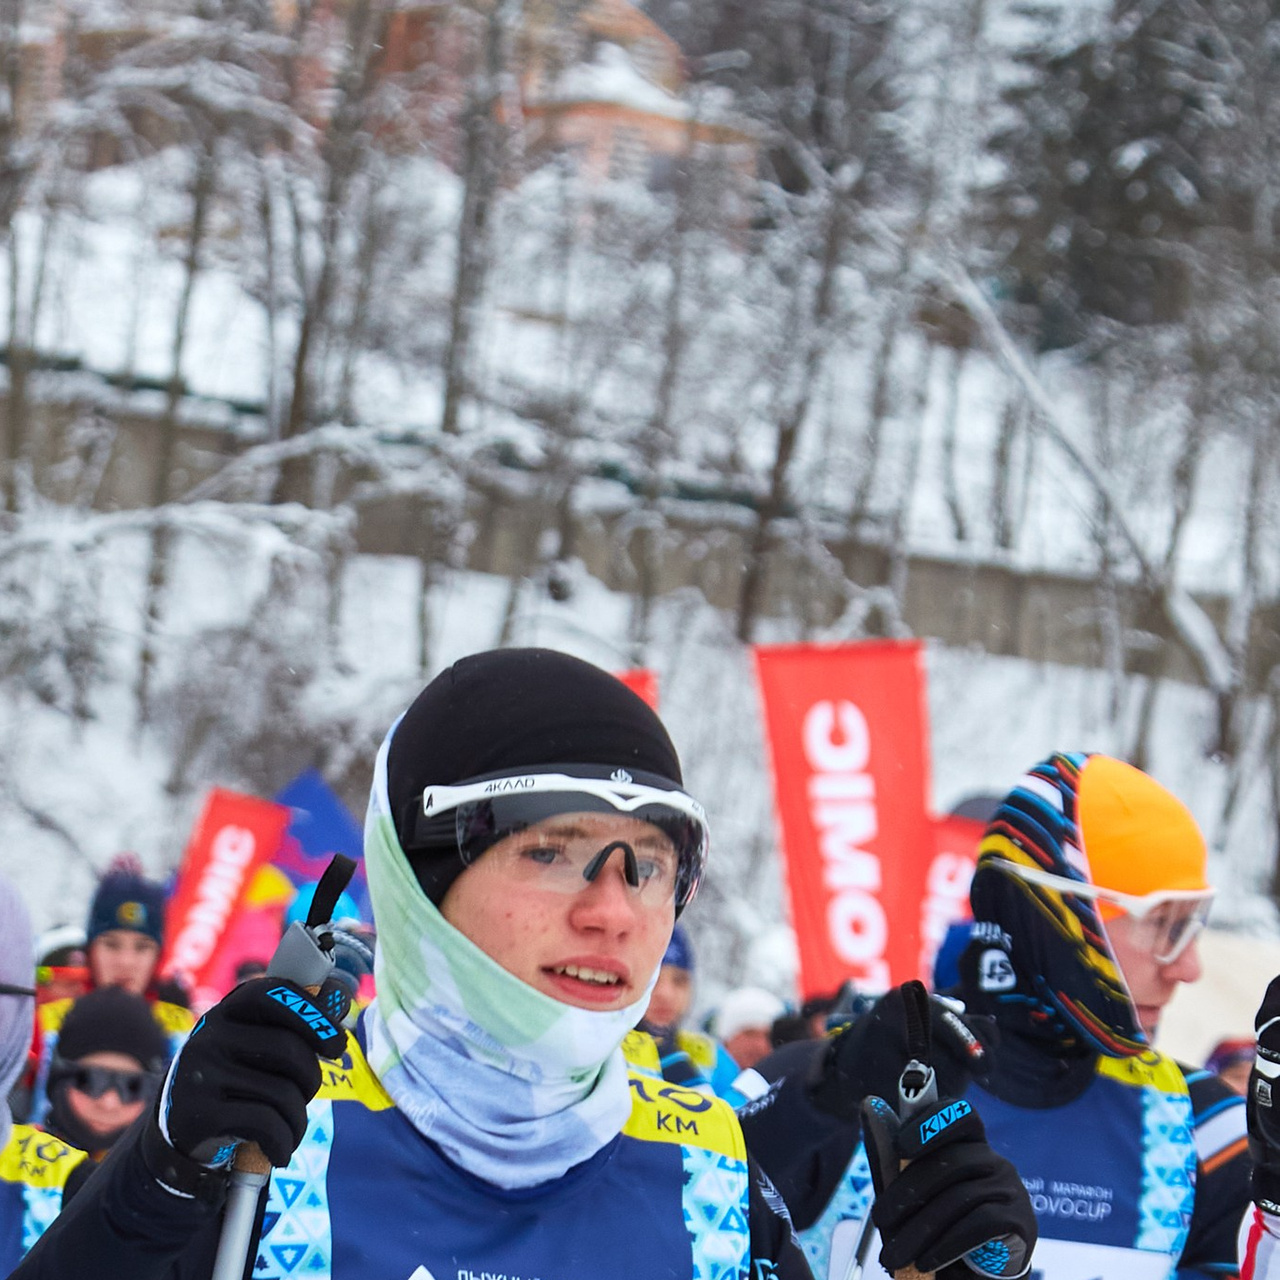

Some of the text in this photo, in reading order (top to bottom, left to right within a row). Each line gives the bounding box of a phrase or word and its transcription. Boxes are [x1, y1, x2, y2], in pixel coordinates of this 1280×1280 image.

[266, 986, 338, 1040] KV+
[920, 1100, 971, 1144] KV+
[1030, 1194, 1112, 1221] OVOCUP
